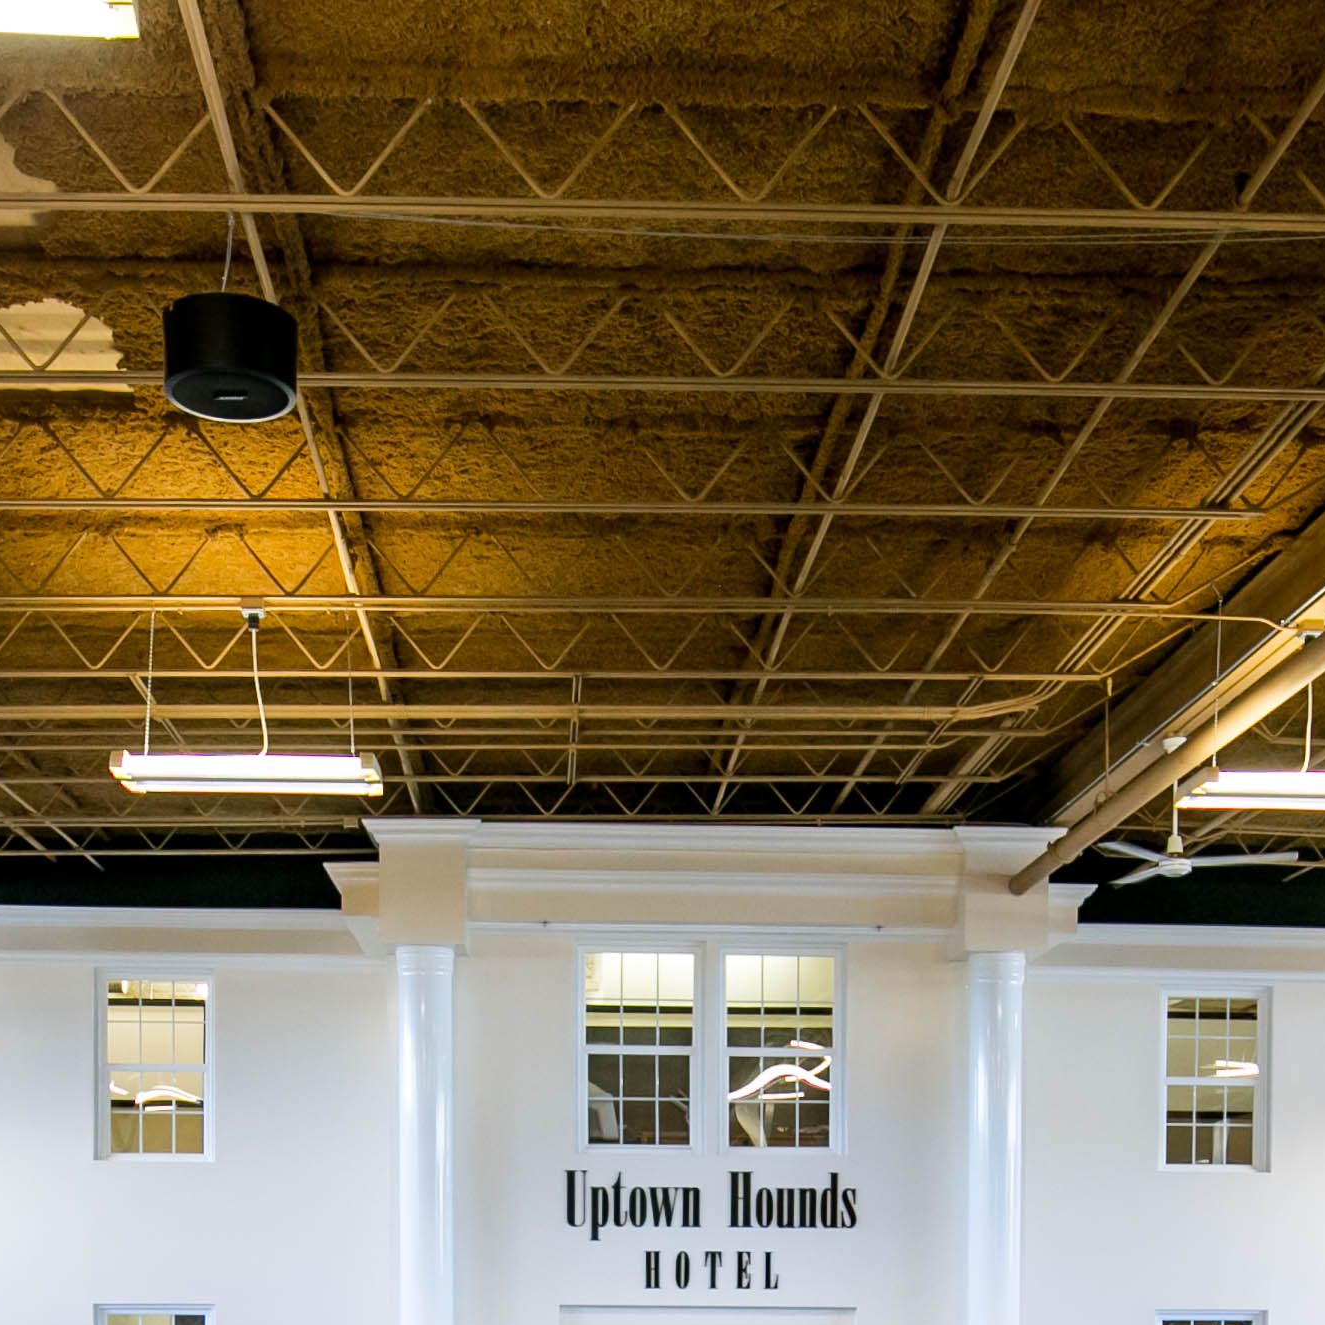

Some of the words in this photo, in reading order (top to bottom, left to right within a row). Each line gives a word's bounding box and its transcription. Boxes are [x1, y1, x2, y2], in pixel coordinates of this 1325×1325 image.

[564, 1169, 702, 1242] Uptown
[727, 1170, 858, 1229] Hounds
[643, 1250, 780, 1290] HOTEL
